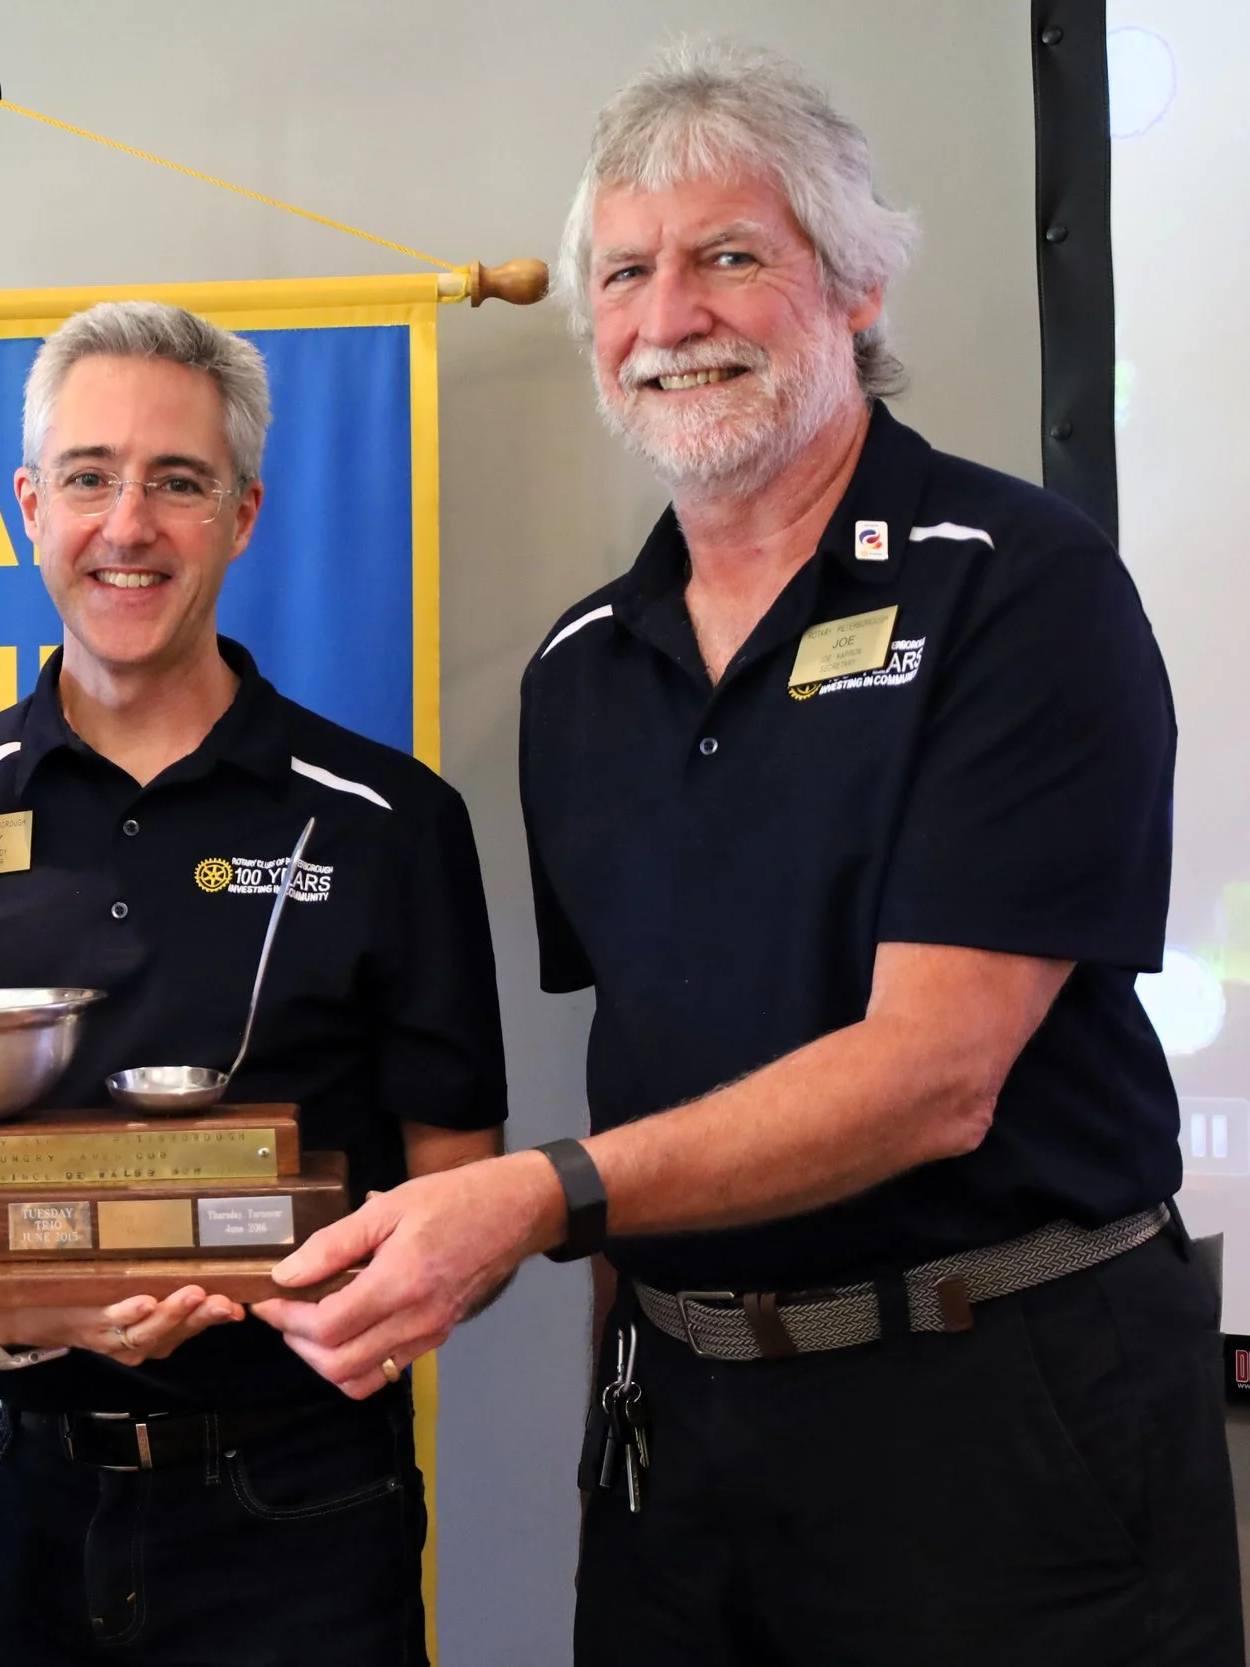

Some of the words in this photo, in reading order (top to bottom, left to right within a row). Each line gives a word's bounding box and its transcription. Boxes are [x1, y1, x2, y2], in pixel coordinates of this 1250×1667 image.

[832, 635, 856, 649] JOE
[872, 647, 924, 674] ARS
[275, 858, 285, 866] OF
[235, 867, 262, 885] 100
[227, 884, 273, 894] INVESTING
[286, 887, 329, 902] OMMUNITY
[22, 1207, 74, 1219] TUESDAY
[207, 1209, 243, 1220] Thursday
[248, 1208, 283, 1219] Turnover
[34, 1220, 62, 1231] TRIO
[224, 1223, 244, 1233] June
[21, 1232, 50, 1243] JUNE
[55, 1231, 79, 1242] 2015
